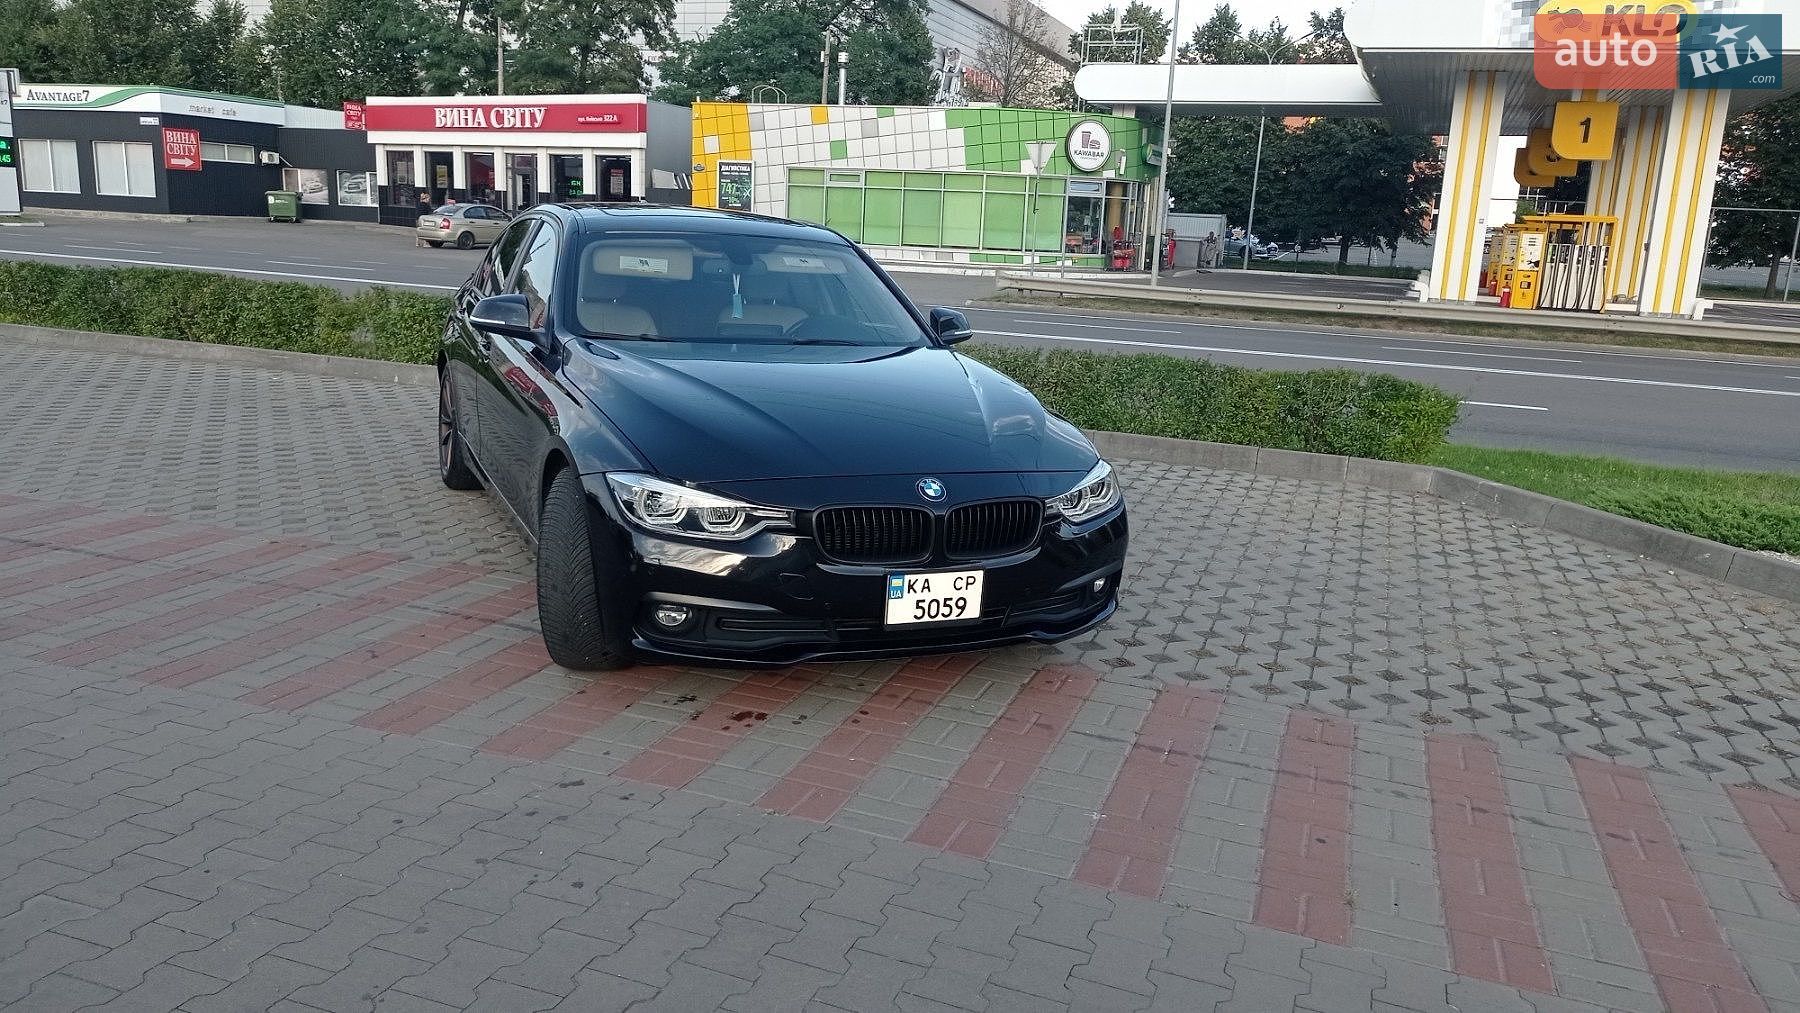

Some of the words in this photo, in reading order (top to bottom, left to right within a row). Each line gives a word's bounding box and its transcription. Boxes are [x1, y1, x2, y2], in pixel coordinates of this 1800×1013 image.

[1601, 5, 1689, 36] KLO
[434, 107, 488, 128] ВИНА
[490, 107, 548, 129] СВІТУ
[165, 131, 197, 145] ВИНА
[1580, 117, 1592, 143] 1
[166, 143, 197, 156] СВІТУ
[891, 590, 903, 598] UA
[907, 578, 931, 594] KA
[953, 575, 976, 591] CP
[913, 597, 967, 620] 5059
